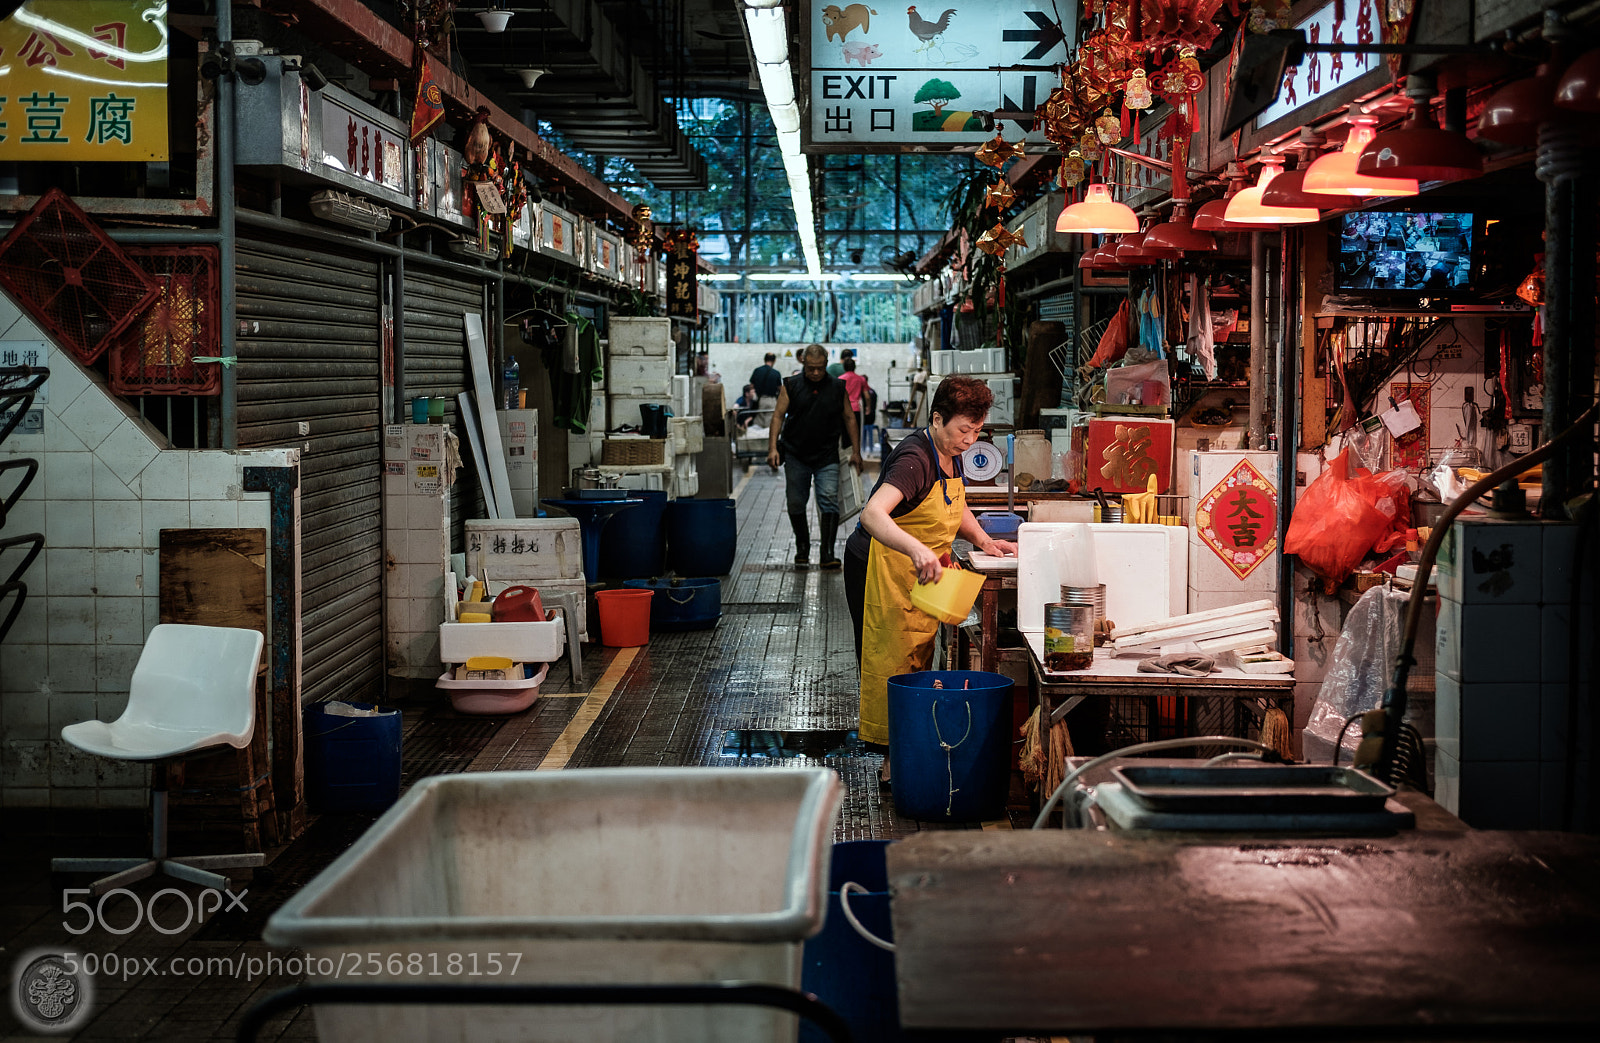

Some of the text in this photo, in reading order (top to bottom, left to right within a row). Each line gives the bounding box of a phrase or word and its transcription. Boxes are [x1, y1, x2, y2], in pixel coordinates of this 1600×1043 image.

[0, 22, 127, 70] 公司
[822, 75, 897, 100] EXIT
[0, 92, 136, 145] 荳腐
[825, 106, 895, 133] 出口
[2, 350, 39, 366] 地滑
[1100, 424, 1159, 489] 福
[1227, 490, 1265, 548] 大吉
